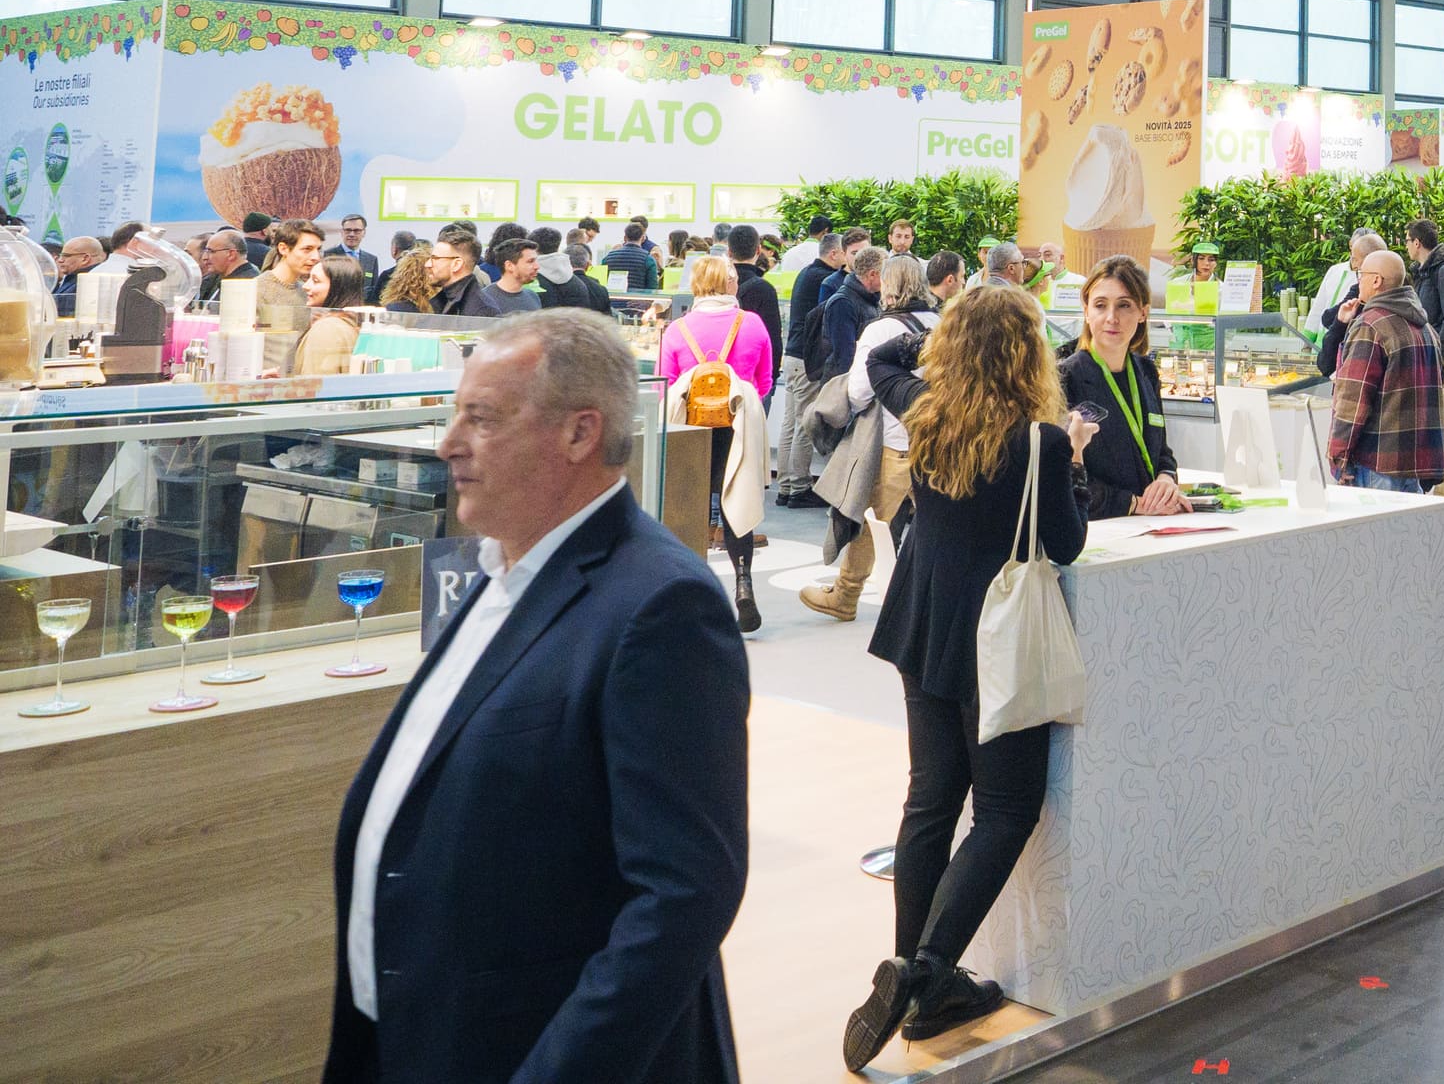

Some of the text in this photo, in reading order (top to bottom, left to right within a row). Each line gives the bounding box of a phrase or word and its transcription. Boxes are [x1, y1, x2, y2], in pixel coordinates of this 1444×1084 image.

[1035, 26, 1067, 37] PreGel
[35, 72, 91, 92] Le nostre filiali
[33, 95, 46, 108] Our
[513, 92, 722, 145] GELATO
[1146, 120, 1192, 131] NOVITÀ 2025
[1135, 134, 1151, 142] BASE
[927, 131, 1014, 158] PreGel
[1333, 150, 1358, 160] SEMPRE
